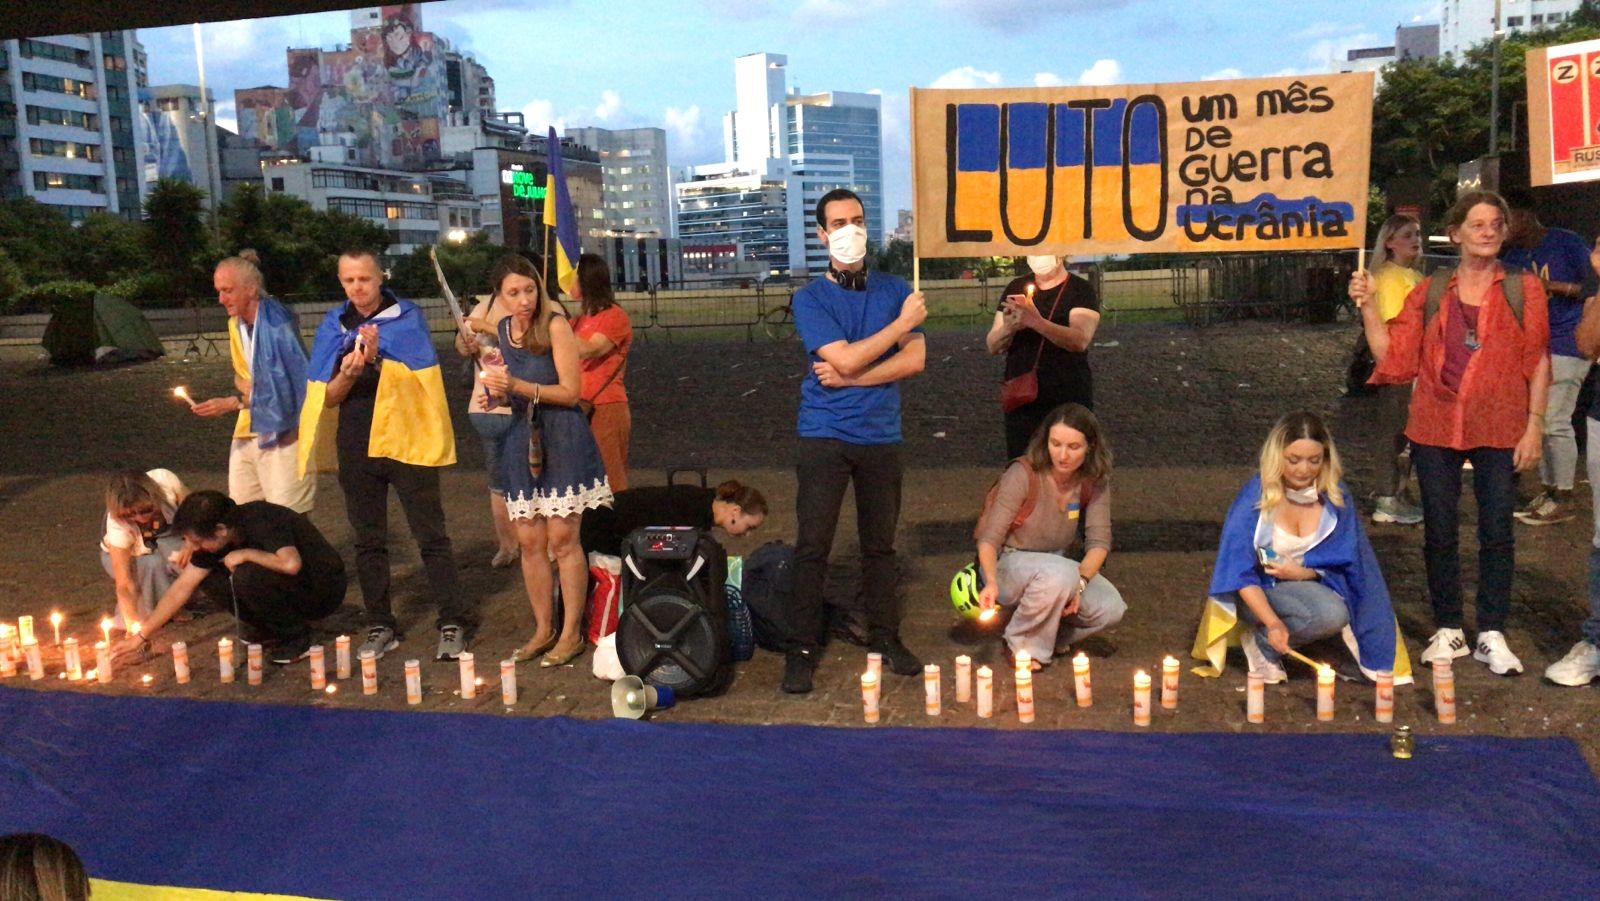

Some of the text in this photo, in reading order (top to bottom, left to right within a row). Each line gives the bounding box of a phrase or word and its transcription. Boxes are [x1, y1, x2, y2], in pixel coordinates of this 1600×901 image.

[1181, 80, 1335, 123] um mês
[945, 94, 1169, 247] LUTO
[1179, 142, 1334, 187] Guerra
[1185, 186, 1236, 206] na
[1184, 201, 1349, 242] Ucrânia
